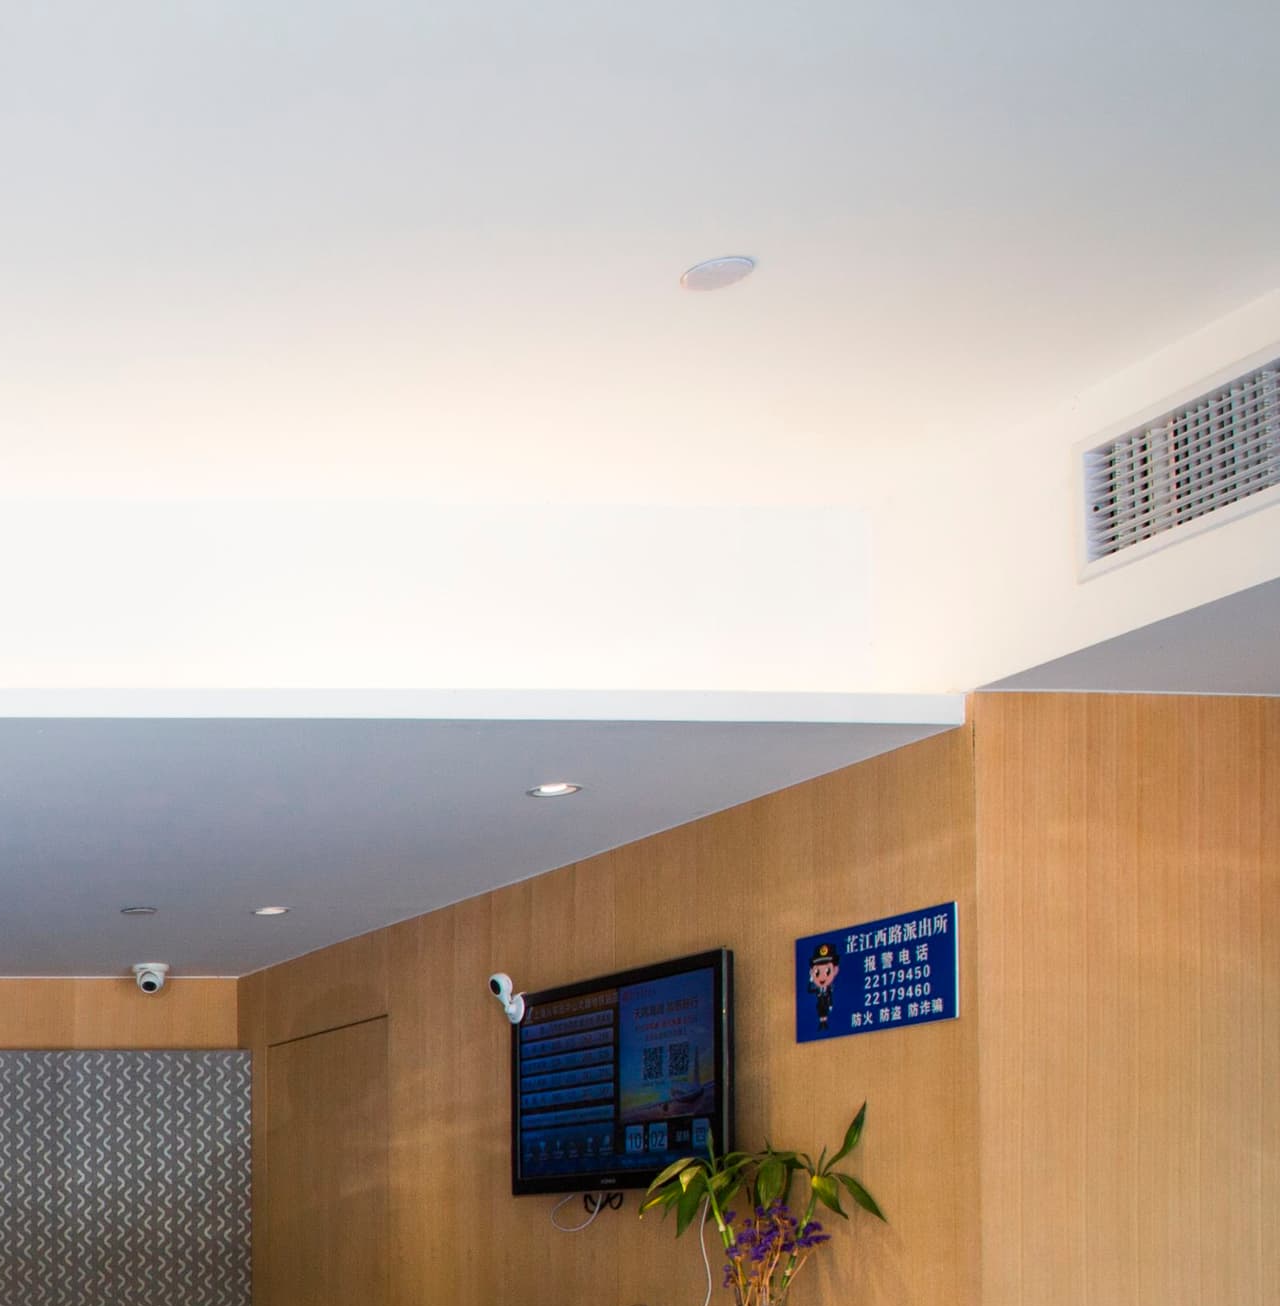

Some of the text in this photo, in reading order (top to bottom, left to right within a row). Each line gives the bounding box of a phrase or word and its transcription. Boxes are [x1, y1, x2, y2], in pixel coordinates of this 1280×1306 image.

[846, 913, 948, 953] 芷江西路派出所
[864, 943, 929, 973] 报警电话
[864, 965, 931, 989] 22179450
[864, 982, 931, 1006] 22179460
[851, 998, 944, 1028] 防火 防盗 防诈骗
